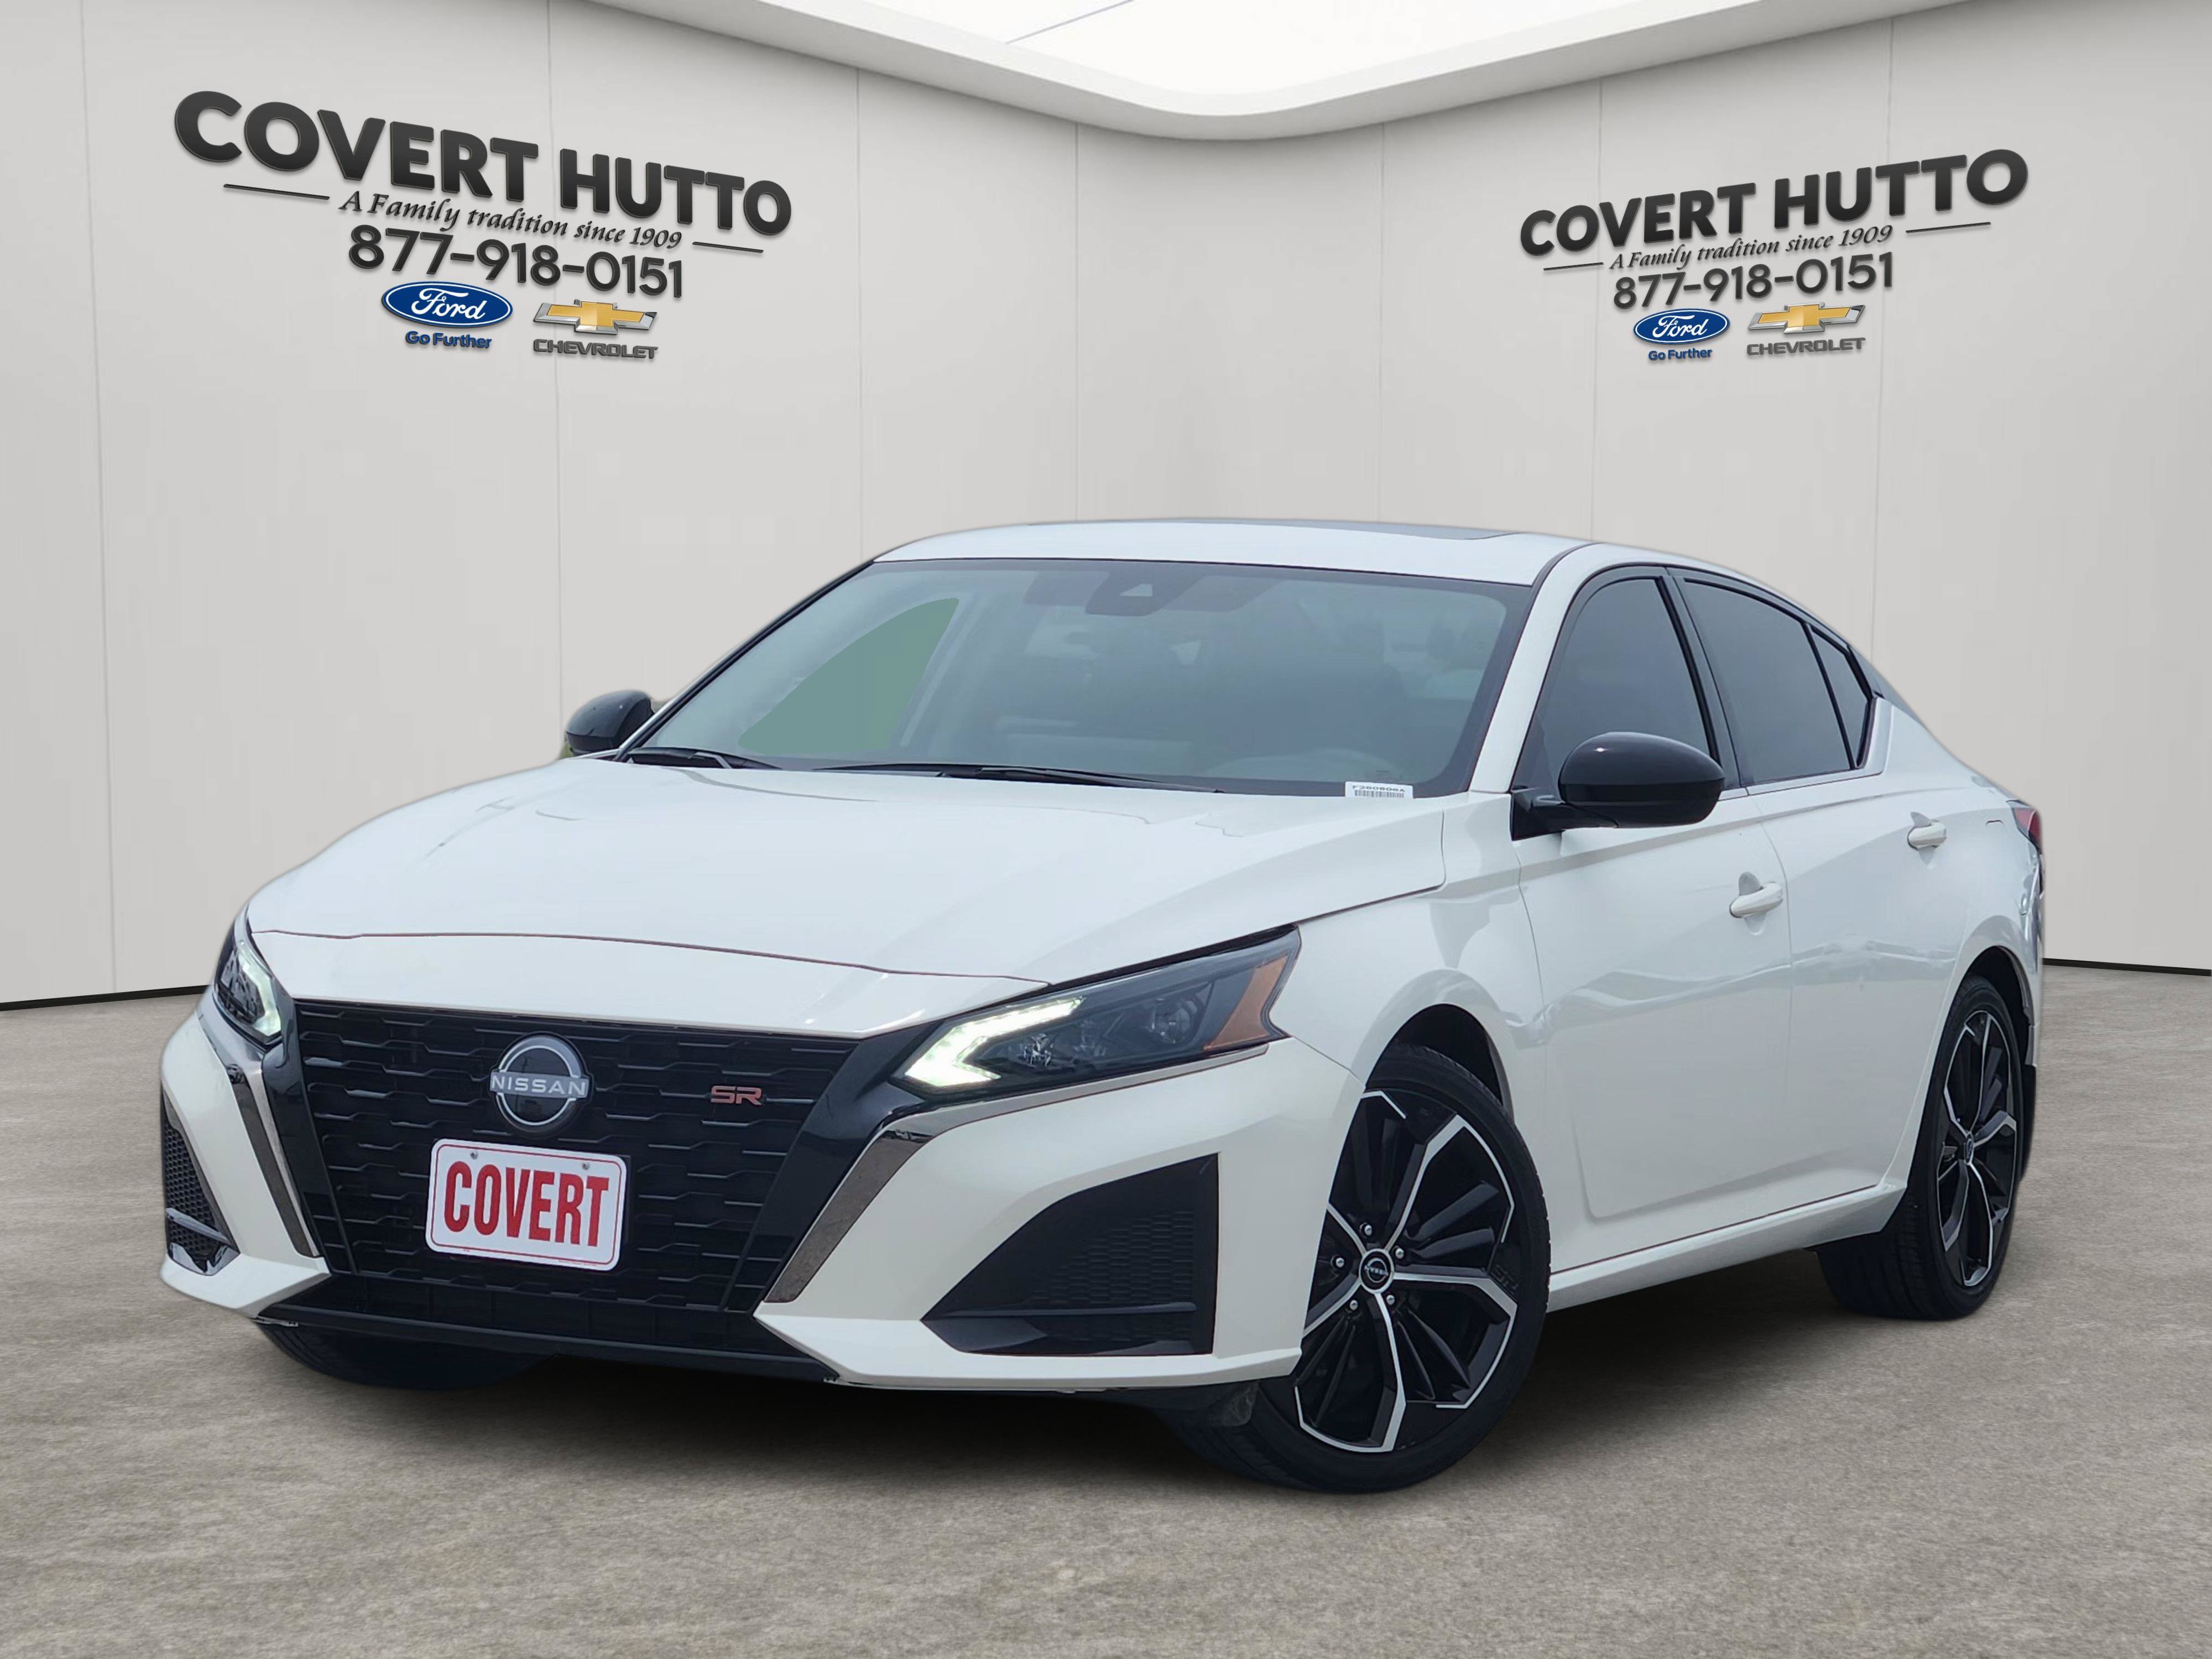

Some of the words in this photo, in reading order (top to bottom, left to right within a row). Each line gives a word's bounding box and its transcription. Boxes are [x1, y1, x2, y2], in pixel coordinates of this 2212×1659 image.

[175, 91, 539, 202] COVERT
[559, 148, 791, 236] HUTTO
[1520, 182, 1756, 256] COVERT
[1774, 149, 2028, 228] HUTTO
[338, 191, 362, 212] A
[367, 193, 461, 231] Family
[468, 208, 568, 236] tradition
[574, 221, 626, 242] since
[629, 227, 682, 249] 1909
[348, 224, 682, 298] 877-918-0151
[1609, 253, 1624, 269] A
[1626, 243, 1692, 270] Family
[1697, 238, 1780, 261] tradition
[1785, 234, 1834, 252] since
[1838, 225, 1893, 246] 1909
[1614, 252, 1892, 309] 877-918-0151
[411, 287, 487, 320] Ford
[405, 330, 431, 345] Go
[433, 332, 492, 349] Further
[1652, 314, 1709, 338] Ford
[533, 338, 659, 359] CHEVROLET
[1648, 349, 1666, 361] Go
[1667, 348, 1713, 359] Further
[1746, 337, 1866, 356] CHEVROLET
[491, 1074, 586, 1097] NISSAN
[710, 1084, 762, 1105] SR
[444, 1161, 609, 1248] COVERT
